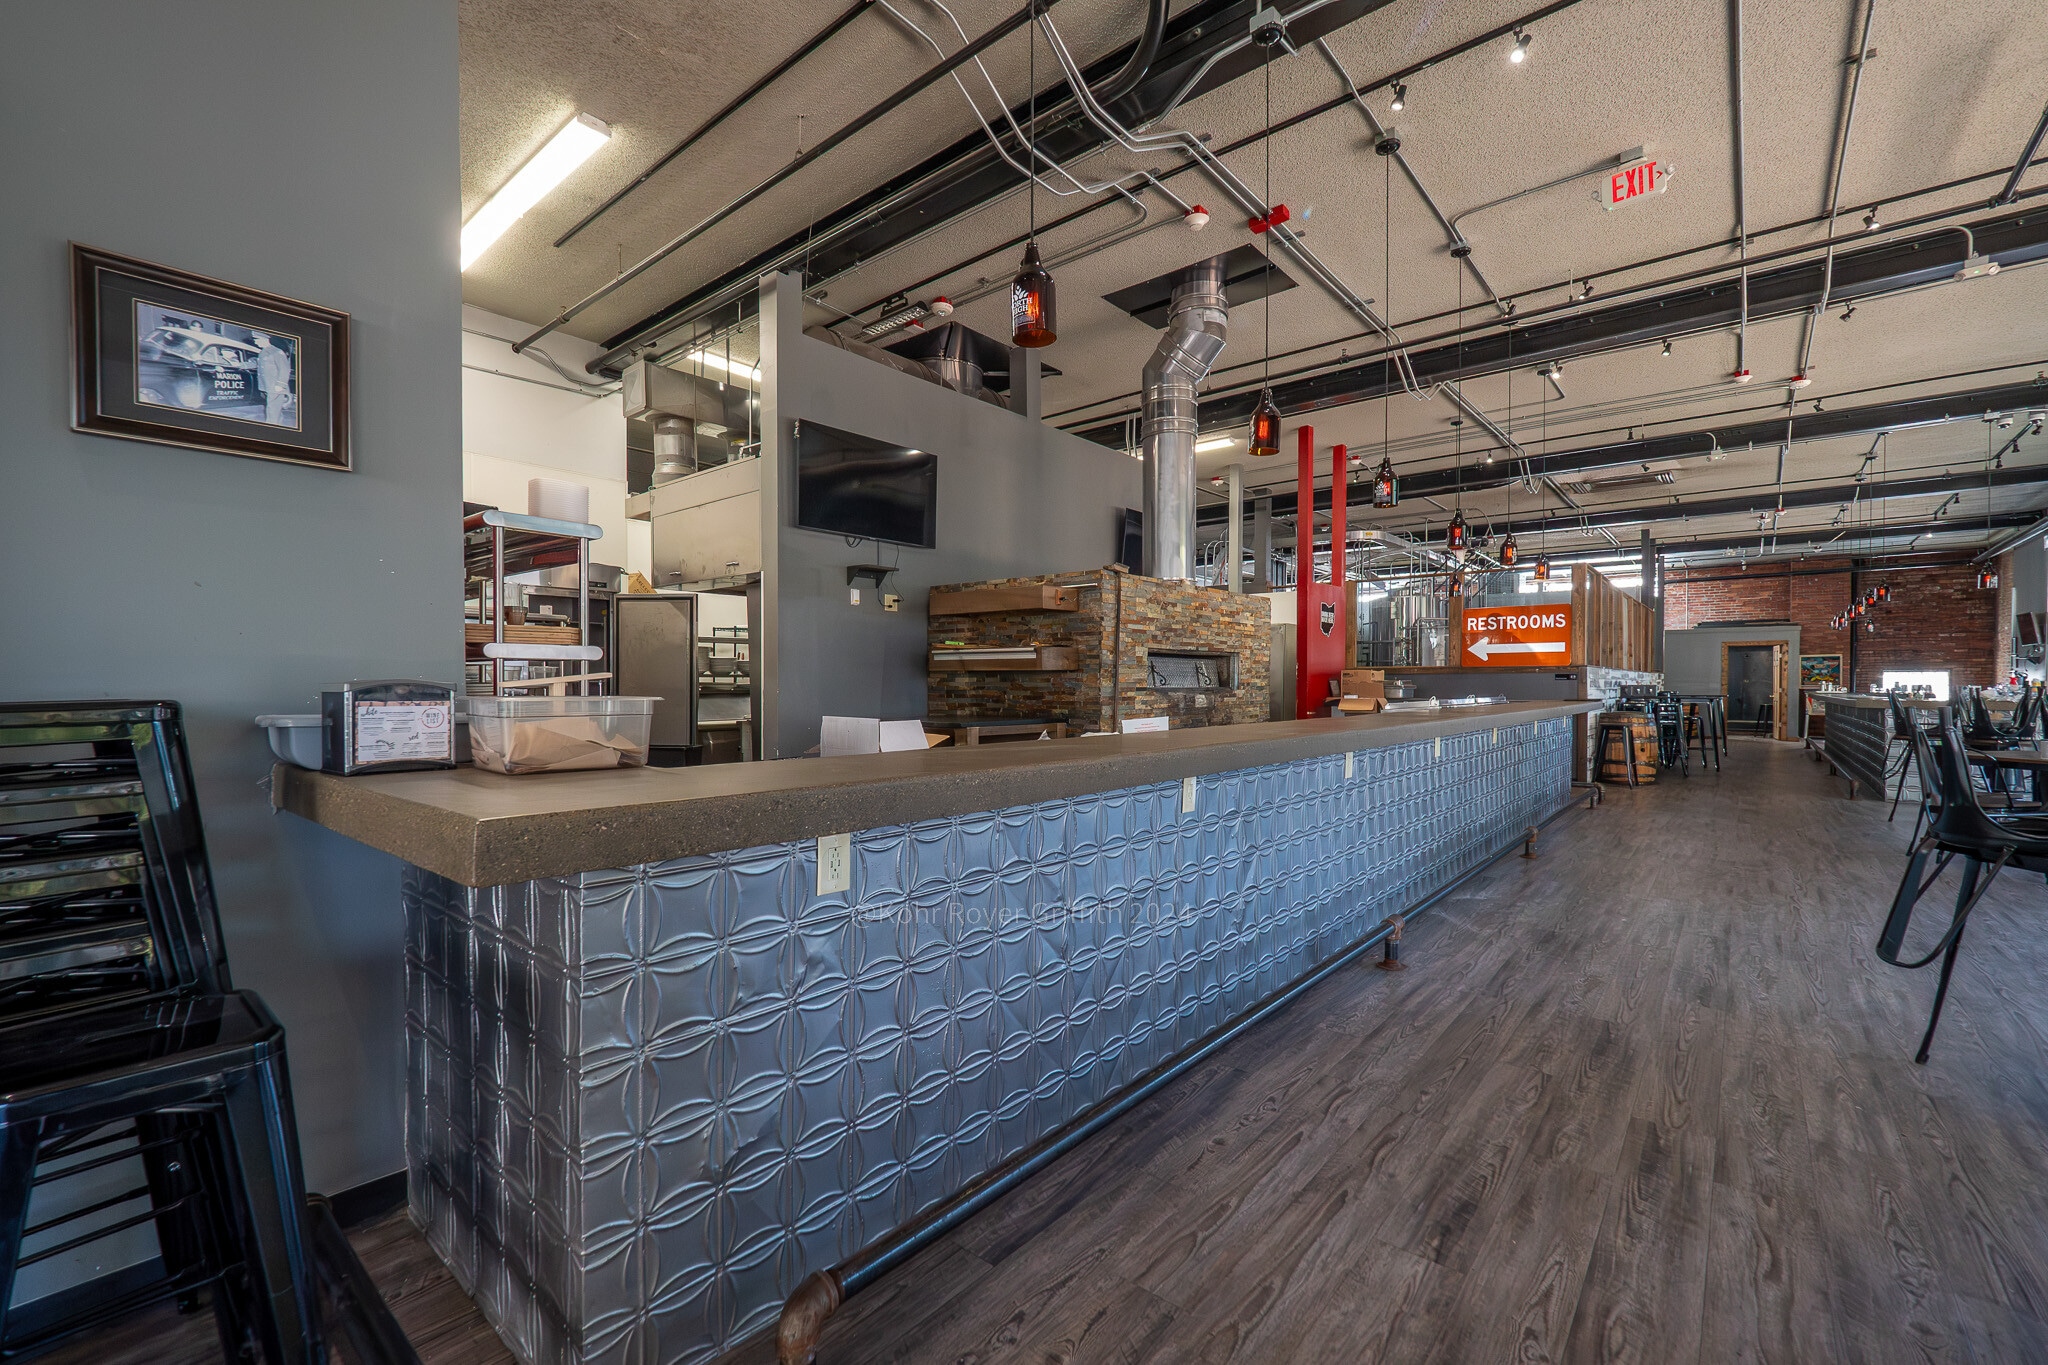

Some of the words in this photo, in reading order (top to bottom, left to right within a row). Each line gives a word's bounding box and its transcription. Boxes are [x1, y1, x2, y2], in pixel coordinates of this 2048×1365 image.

[1611, 161, 1657, 203] EXIT
[1012, 297, 1033, 309] ORTH
[214, 380, 245, 389] POLICE
[1467, 613, 1566, 631] RESTROOMS
